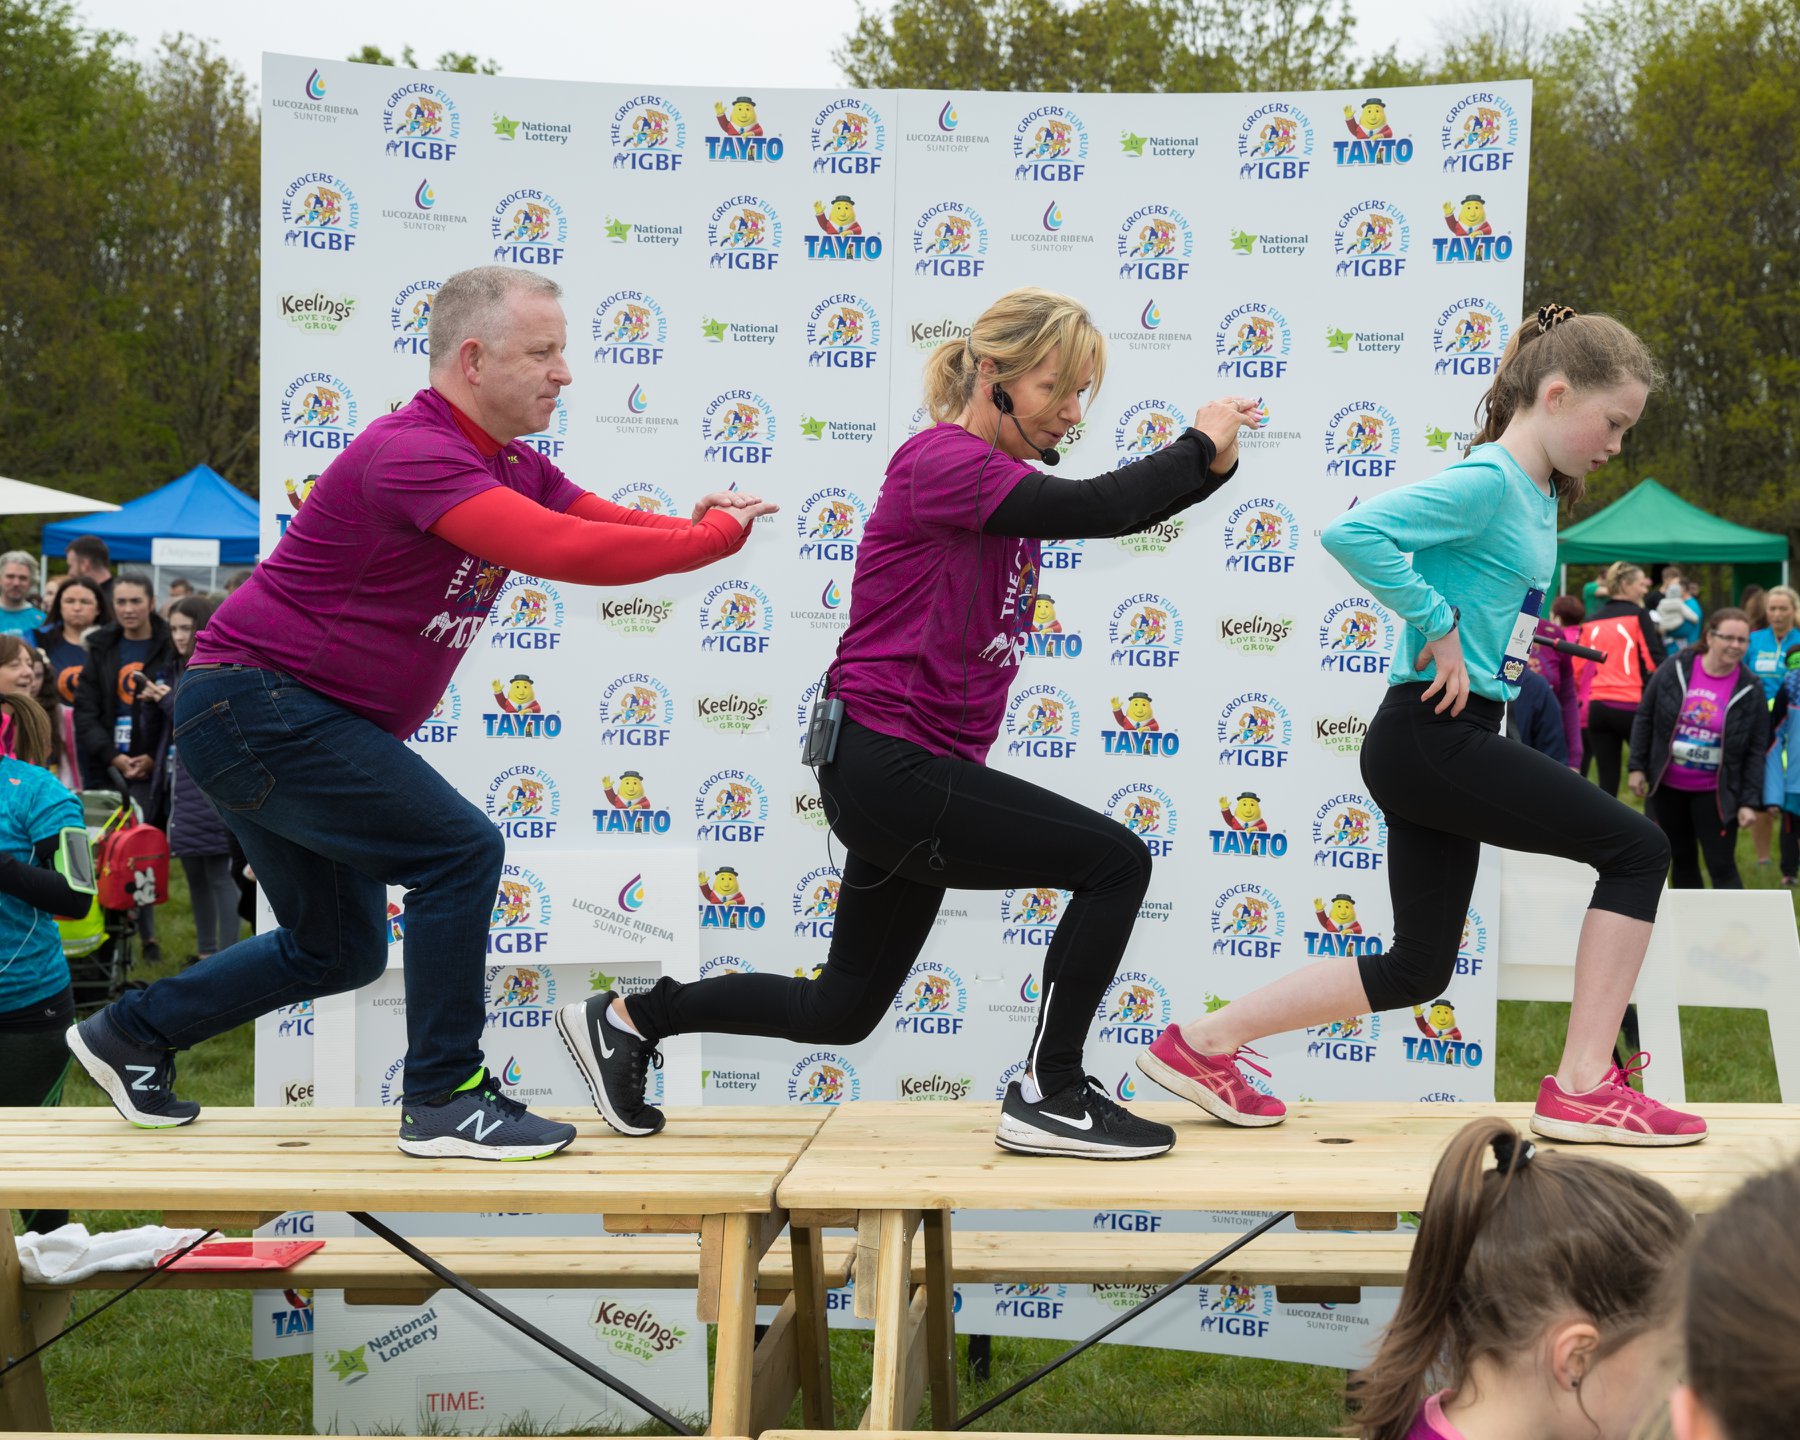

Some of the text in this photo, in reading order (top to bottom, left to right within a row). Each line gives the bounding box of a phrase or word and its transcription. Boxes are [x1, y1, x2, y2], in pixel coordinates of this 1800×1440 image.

[272, 99, 358, 115] LUCOZADE RIBENA
[383, 83, 460, 139] THE GROCERS FUN RUN
[294, 112, 337, 123] SUNTORY
[522, 122, 571, 136] National
[1013, 106, 1088, 159] THE GROCERS FUN RUN
[526, 132, 567, 145] Lottery
[907, 134, 989, 143] LUCOZADE RIBENA
[1150, 137, 1198, 146] National
[404, 140, 457, 161] IGBF
[705, 136, 784, 162] TAYTO
[927, 144, 968, 152] SUNTORY
[1153, 147, 1195, 158] Lottery
[1333, 138, 1413, 165] TAYTO
[632, 153, 682, 171] IGBF
[832, 157, 881, 174] IGBF
[1258, 162, 1310, 179] IGBF
[1462, 152, 1513, 172] IGBF
[1033, 164, 1085, 181] IGBF
[383, 210, 467, 223] LUCOZADE RIBENA
[708, 195, 782, 248] THE GROCERS FUN RUN
[403, 222, 446, 231] SUNTORY
[634, 224, 682, 234] National
[1334, 200, 1410, 255] THE GROCERS FUN RUN
[304, 231, 355, 251] IGBF
[637, 234, 679, 246] Lottery
[1011, 234, 1058, 242] LUCOZADE
[1260, 235, 1308, 243] National
[513, 246, 564, 265] IGBF
[805, 235, 882, 261] TAYTO
[1031, 244, 1073, 252] SUNTORY
[1263, 245, 1304, 256] Lottery
[1432, 236, 1512, 262] TAYTO
[728, 252, 779, 270] IGBF
[934, 259, 984, 277] IGBF
[1354, 258, 1406, 277] IGBF
[1138, 263, 1189, 280] IGBF
[282, 293, 354, 321] Keelings
[291, 314, 318, 322] LOVE
[305, 322, 337, 331] GROW
[731, 323, 778, 333] National
[1356, 332, 1404, 341] National
[734, 333, 775, 345] Lottery
[1160, 332, 1192, 342] RIBENA
[613, 347, 663, 365] IGBF
[1359, 343, 1400, 354] Lottery
[827, 351, 876, 368] IGBF
[1236, 361, 1287, 378] IGBF
[596, 416, 679, 425] LUCOZADE RIBENA
[702, 389, 776, 442] THE GROCERS FUN RUN
[616, 426, 658, 434] SUNTORY
[829, 422, 876, 431] National
[832, 431, 872, 443] Lottery
[722, 446, 773, 463] IGBF
[1345, 460, 1396, 476] IGBF
[1244, 555, 1295, 573] IGBF
[445, 556, 474, 599] THE
[1000, 571, 1020, 620] THE
[602, 598, 672, 623] Keelings
[611, 618, 636, 626] LOVE
[1109, 593, 1183, 646] THE GROCERS FUN RUN
[624, 625, 655, 633] GROW
[1222, 615, 1292, 644] Keelings
[510, 632, 560, 649] IGBF
[720, 636, 769, 653] IGBF
[1230, 636, 1255, 645] LOVE
[1243, 643, 1275, 651] GROW
[1129, 649, 1180, 667] IGBF
[1339, 655, 1390, 673] IGBF
[599, 673, 674, 725] THE GROCERS FUN RUN
[698, 694, 767, 721] Keelings
[483, 712, 561, 738] TAYTO
[707, 715, 732, 723] LOVE
[720, 722, 750, 730] GROW
[619, 729, 670, 746] IGBF
[1101, 730, 1179, 757] TAYTO
[1026, 741, 1076, 758] IGBF
[1237, 750, 1288, 767] IGBF
[593, 808, 671, 834] TAYTO
[506, 822, 556, 838] IGBF
[715, 825, 765, 842] IGBF
[1210, 830, 1287, 858] TAYTO
[1332, 851, 1383, 870] IGBF
[1211, 883, 1285, 937] THE GROCERS FUN RUN
[573, 896, 673, 943] LUCOZADE RIBENA
[593, 916, 649, 944] SUNTORY
[1230, 939, 1281, 958] IGBF
[1304, 931, 1382, 957] TAYTO
[503, 1010, 552, 1027] IGBF
[914, 1017, 963, 1034] IGBF
[1326, 1042, 1376, 1062] IGBF
[1403, 1036, 1482, 1068] TAYTO
[713, 1071, 760, 1080] National
[716, 1080, 756, 1091] Lottery
[456, 1109, 503, 1142] N
[1112, 1214, 1161, 1232] IGBF
[1212, 1215, 1253, 1225] SUNTORY
[1014, 1301, 1063, 1319] IGBF
[1287, 1308, 1370, 1327] LUCOZADE RIBENA
[367, 1307, 437, 1353] National
[595, 1300, 679, 1352] Keelings
[1219, 1317, 1269, 1337] IGBF
[1307, 1321, 1348, 1332] SUNTORY
[378, 1325, 438, 1364] Lottery
[602, 1327, 650, 1348] LOVE TO
[615, 1338, 655, 1361] GROW
[427, 1391, 485, 1413] TIME:
